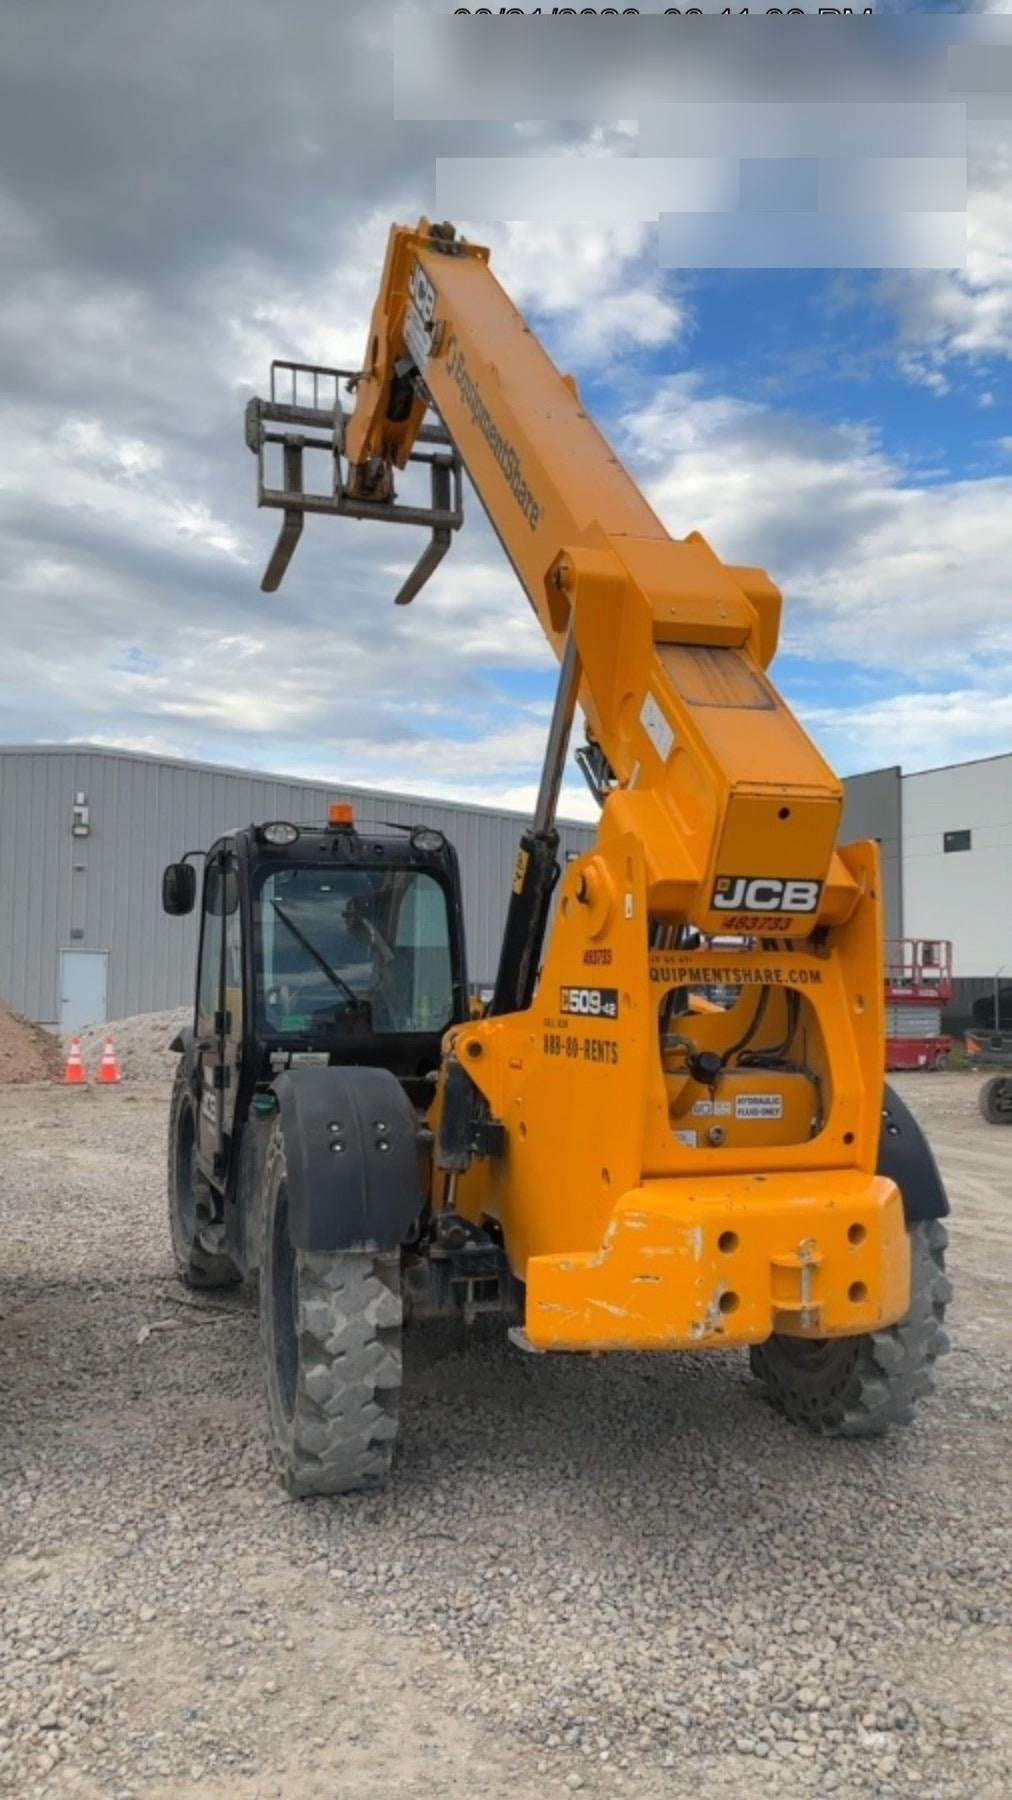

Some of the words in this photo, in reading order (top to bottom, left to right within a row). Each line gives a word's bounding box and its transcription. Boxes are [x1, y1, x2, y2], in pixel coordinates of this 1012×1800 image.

[455, 351, 541, 531] EquipmentShare
[713, 878, 819, 912] JCB
[722, 916, 793, 931] 483733
[650, 967, 822, 983] QUIPMENTSHARE.COM
[737, 1097, 780, 1105] HYDRAULIC
